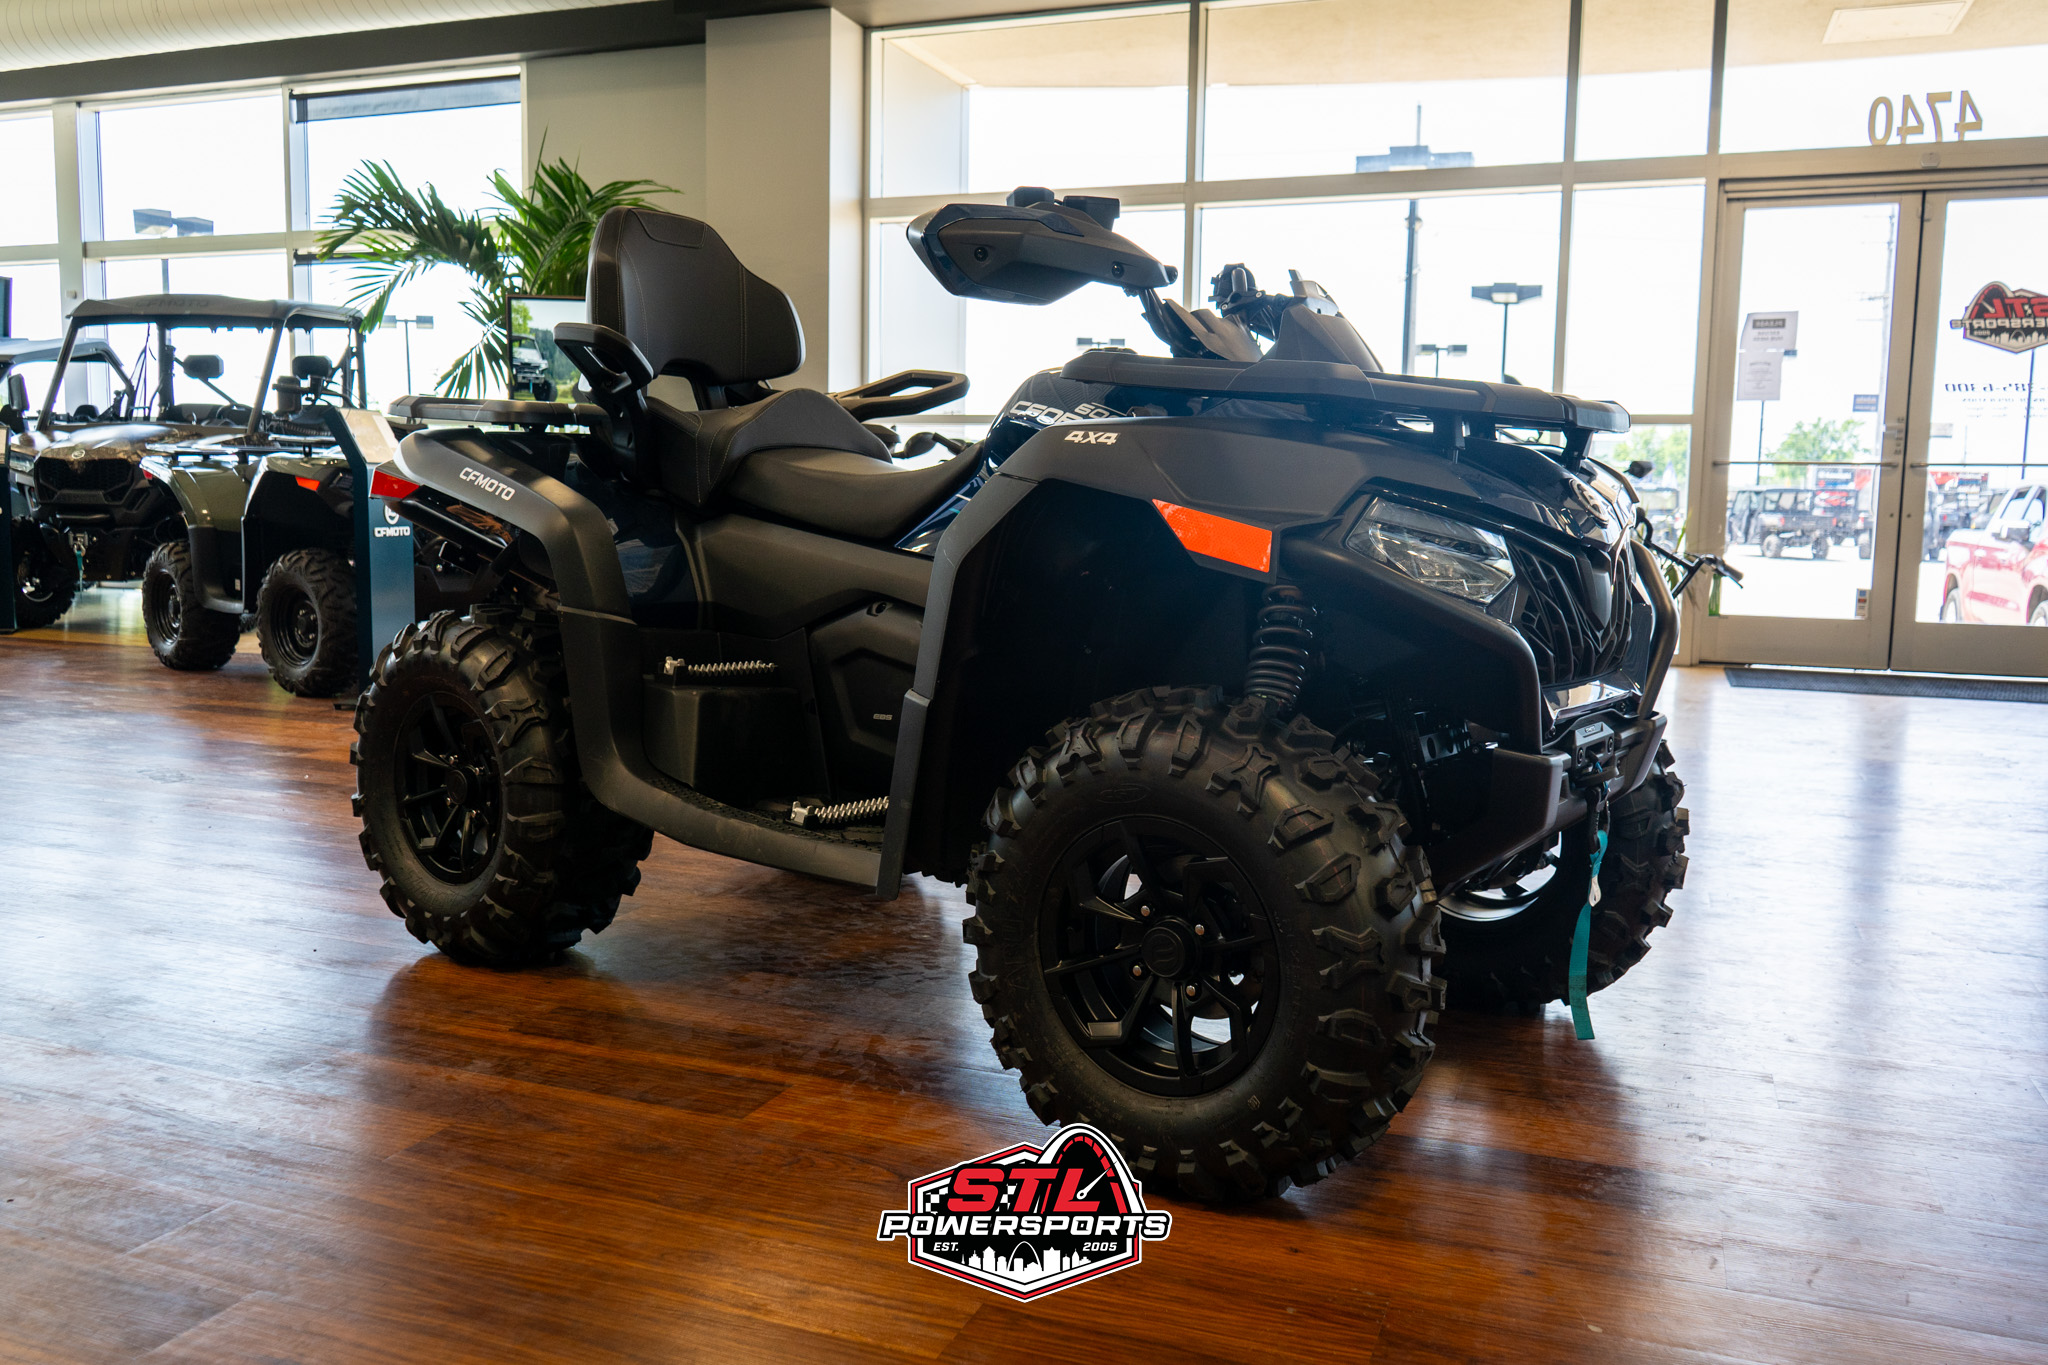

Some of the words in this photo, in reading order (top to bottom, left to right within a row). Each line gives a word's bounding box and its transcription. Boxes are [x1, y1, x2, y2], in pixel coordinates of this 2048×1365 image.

[1074, 402, 1118, 419] 60
[459, 467, 516, 501] CFMOTO
[374, 526, 411, 538] CFMOTO
